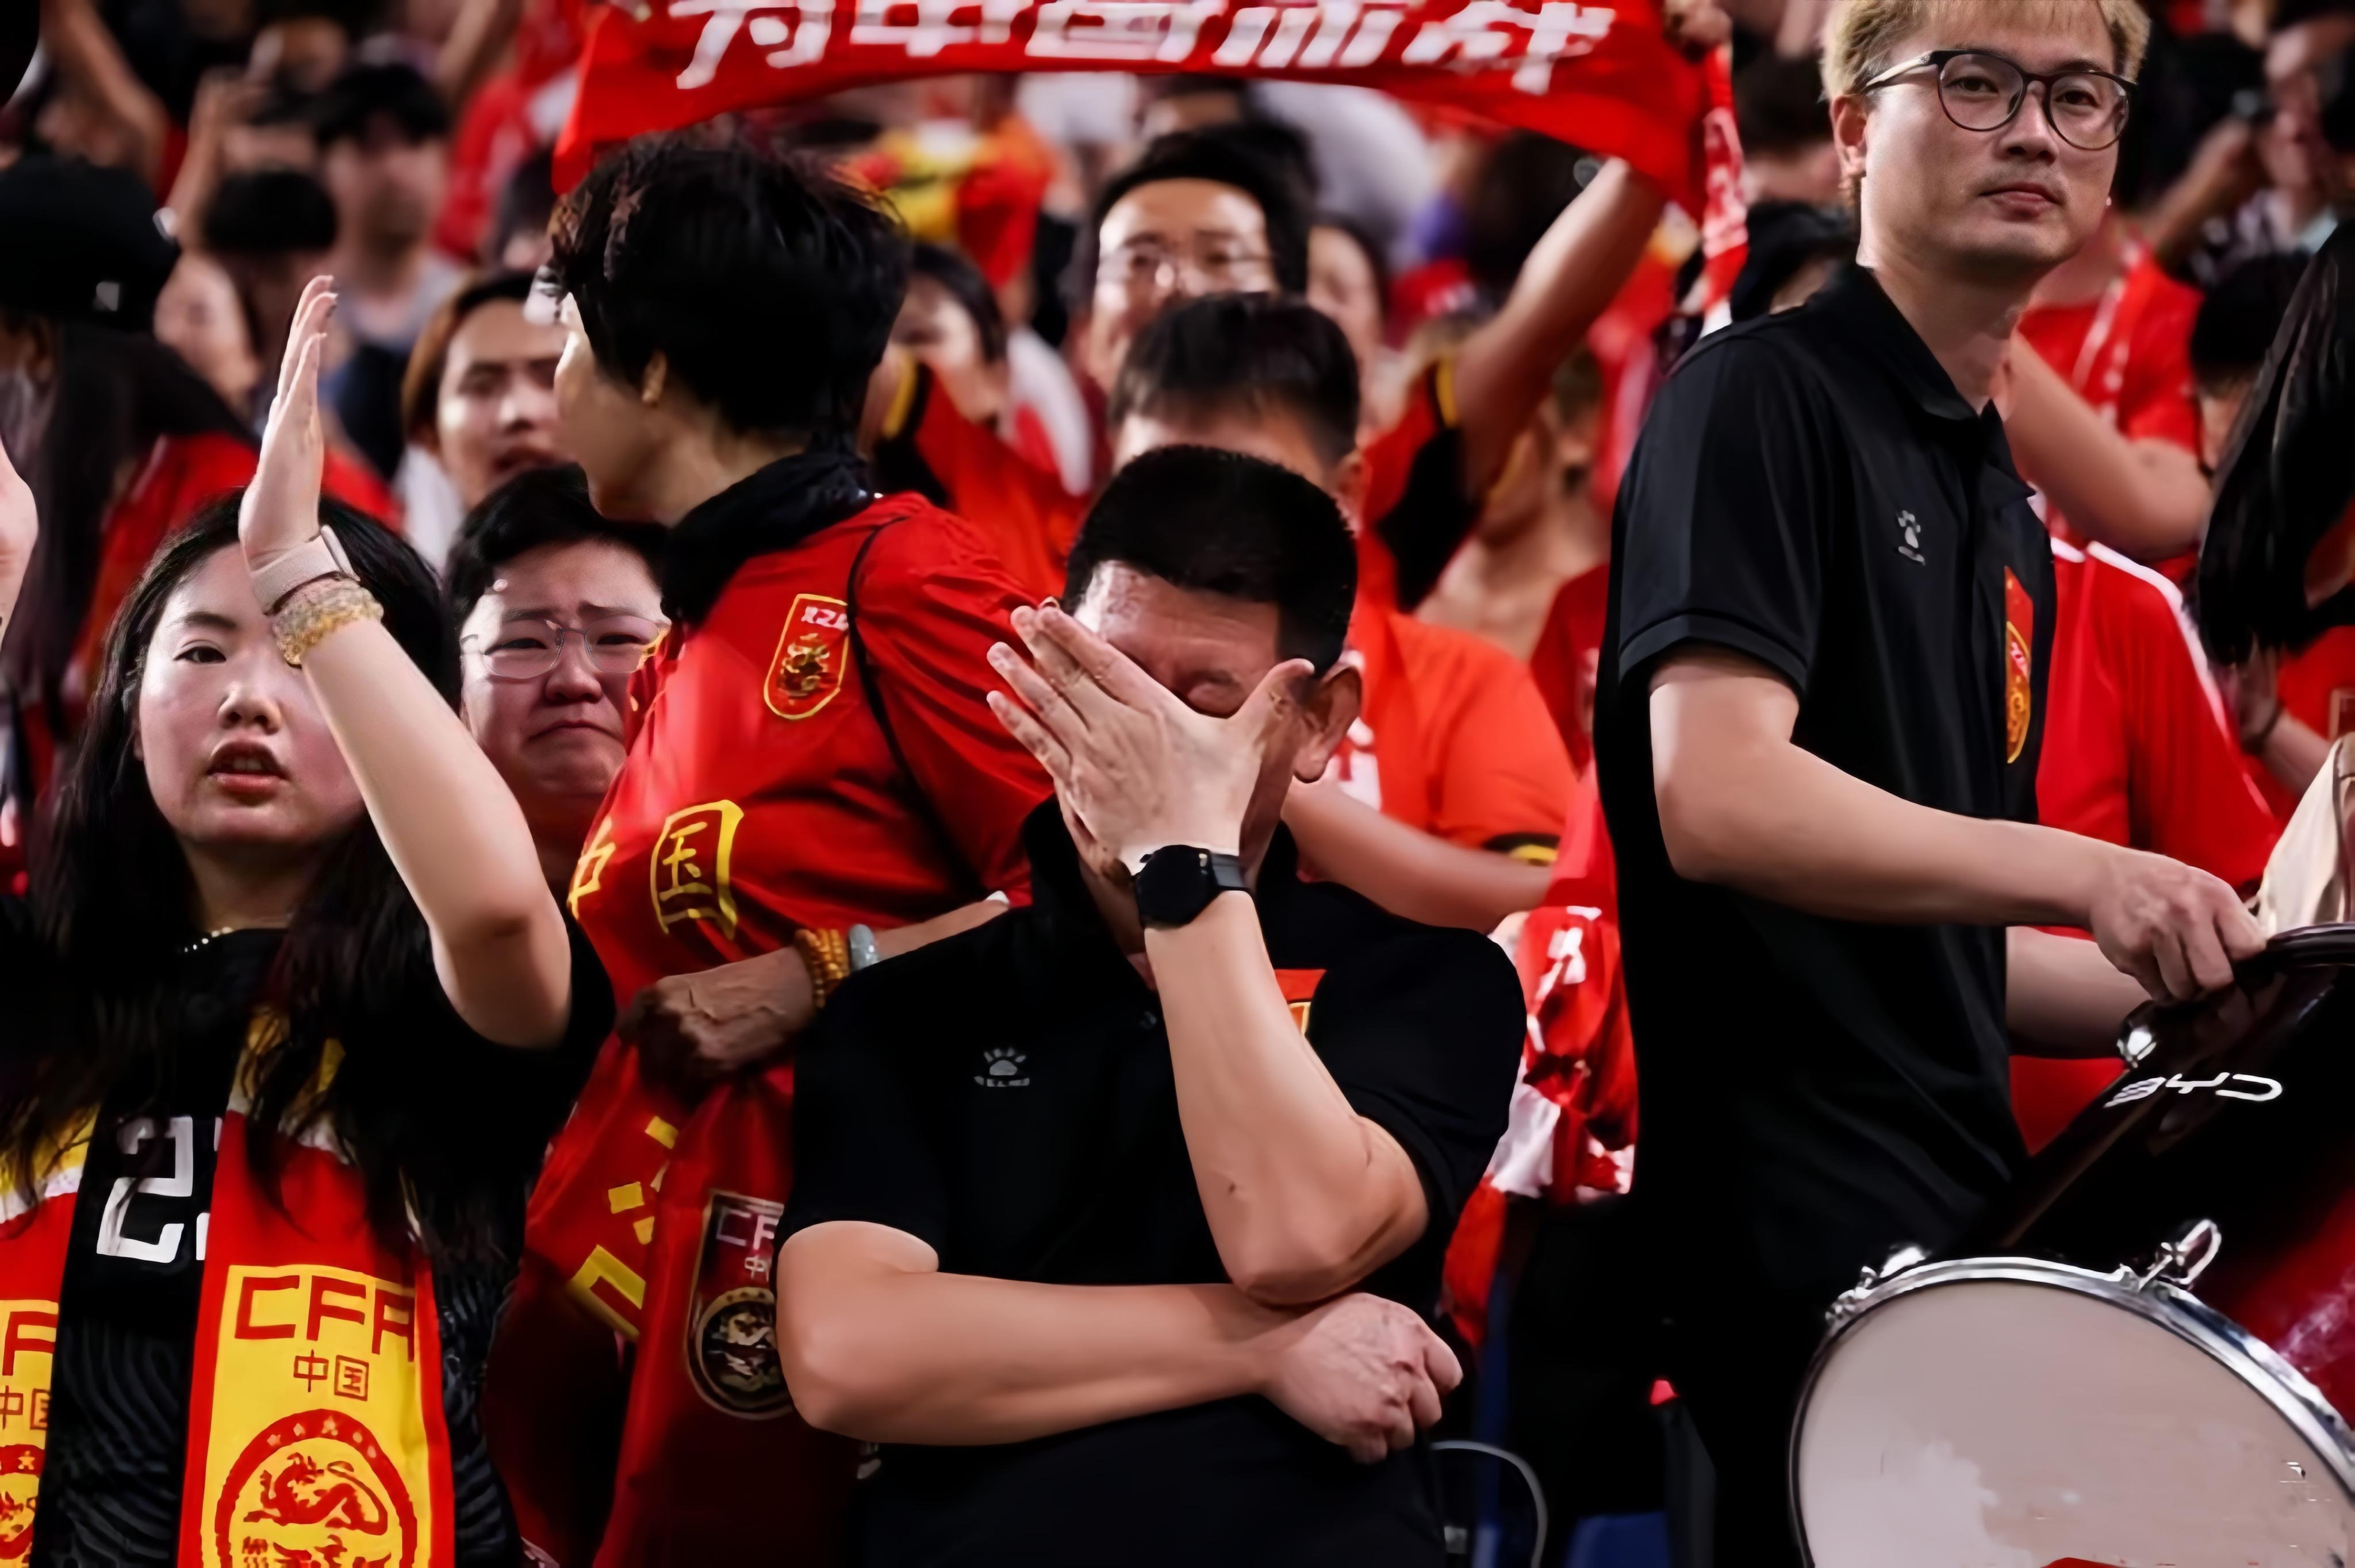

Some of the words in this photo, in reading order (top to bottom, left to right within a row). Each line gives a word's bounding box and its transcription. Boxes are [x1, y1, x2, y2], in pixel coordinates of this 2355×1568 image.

[96, 1114, 223, 1263] 2
[716, 1207, 779, 1250] CF
[235, 1274, 415, 1362] CFA
[293, 1349, 370, 1402] 中国
